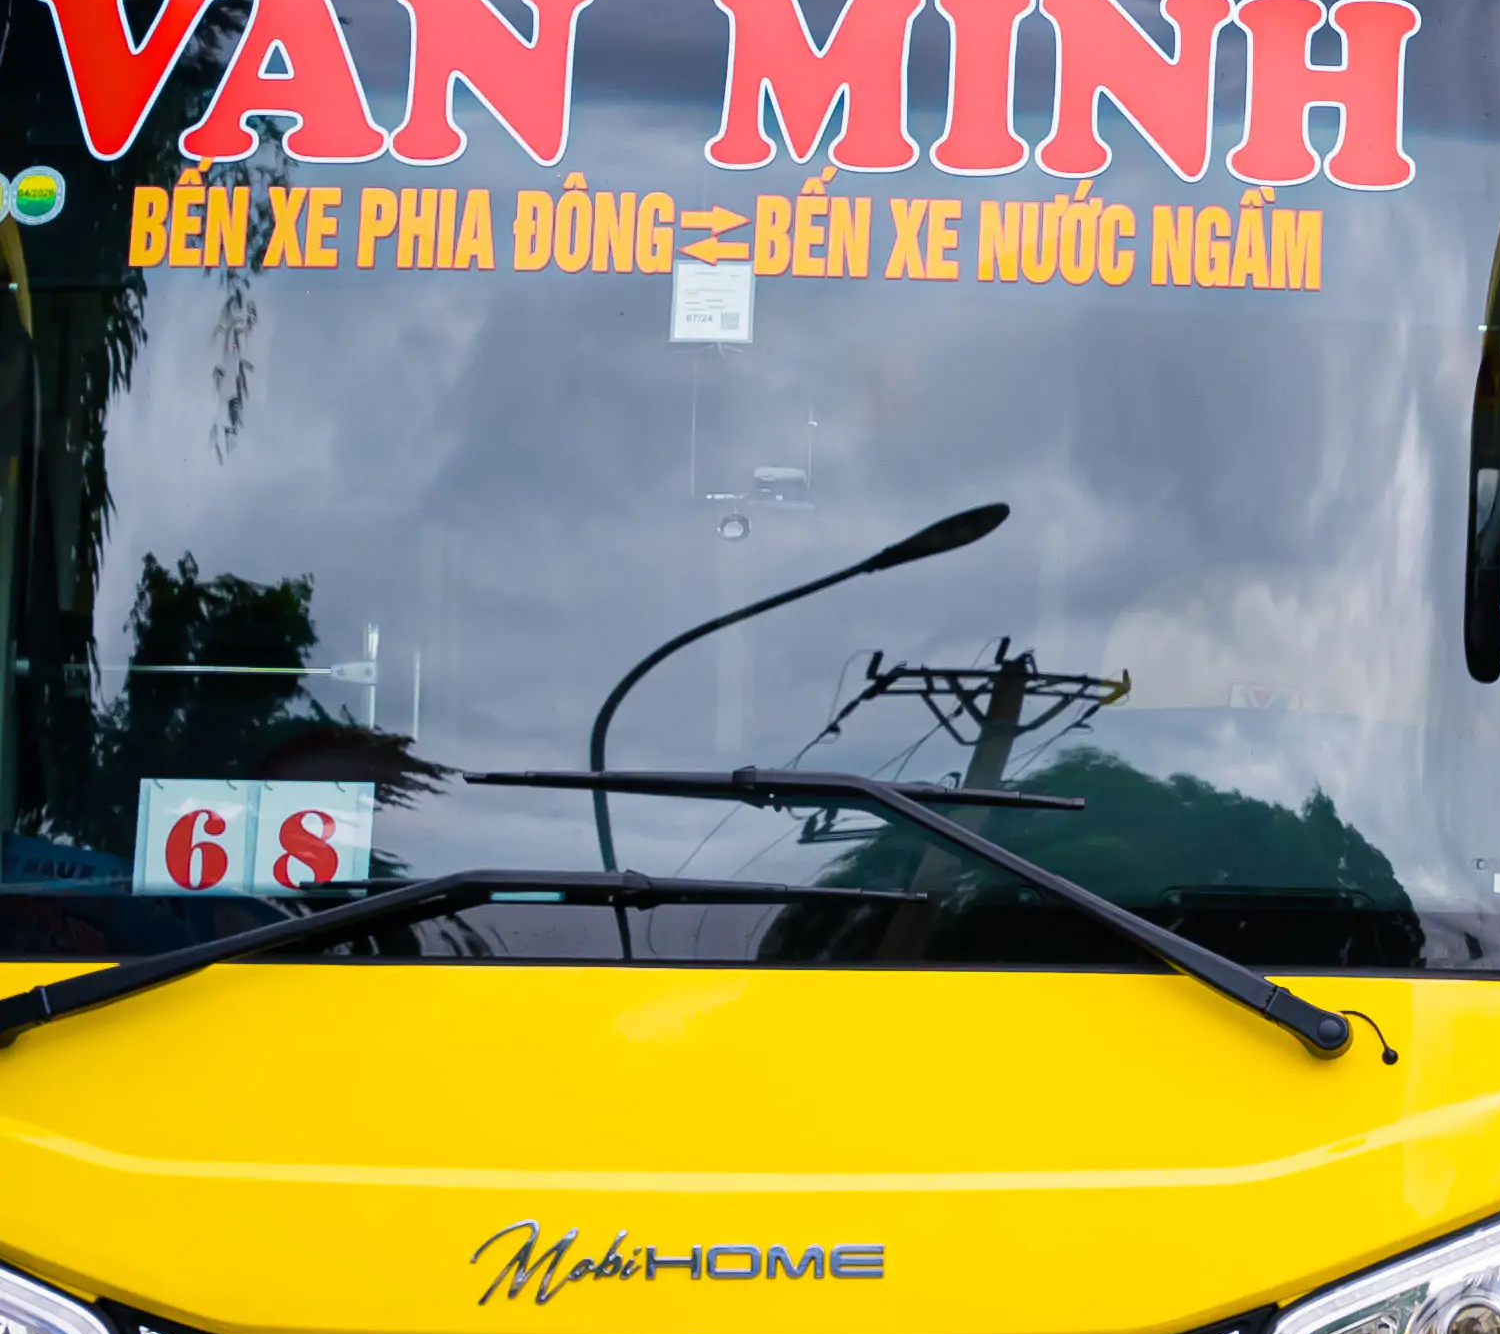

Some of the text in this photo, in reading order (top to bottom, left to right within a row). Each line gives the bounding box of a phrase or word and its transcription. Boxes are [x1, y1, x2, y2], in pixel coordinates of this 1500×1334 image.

[129, 156, 1323, 291] BẾN XE PHIA ĐÔNG BẾN XE NƯỚC NGẦM
[164, 809, 339, 891] 68
[470, 1219, 885, 1305] MobiHOME
